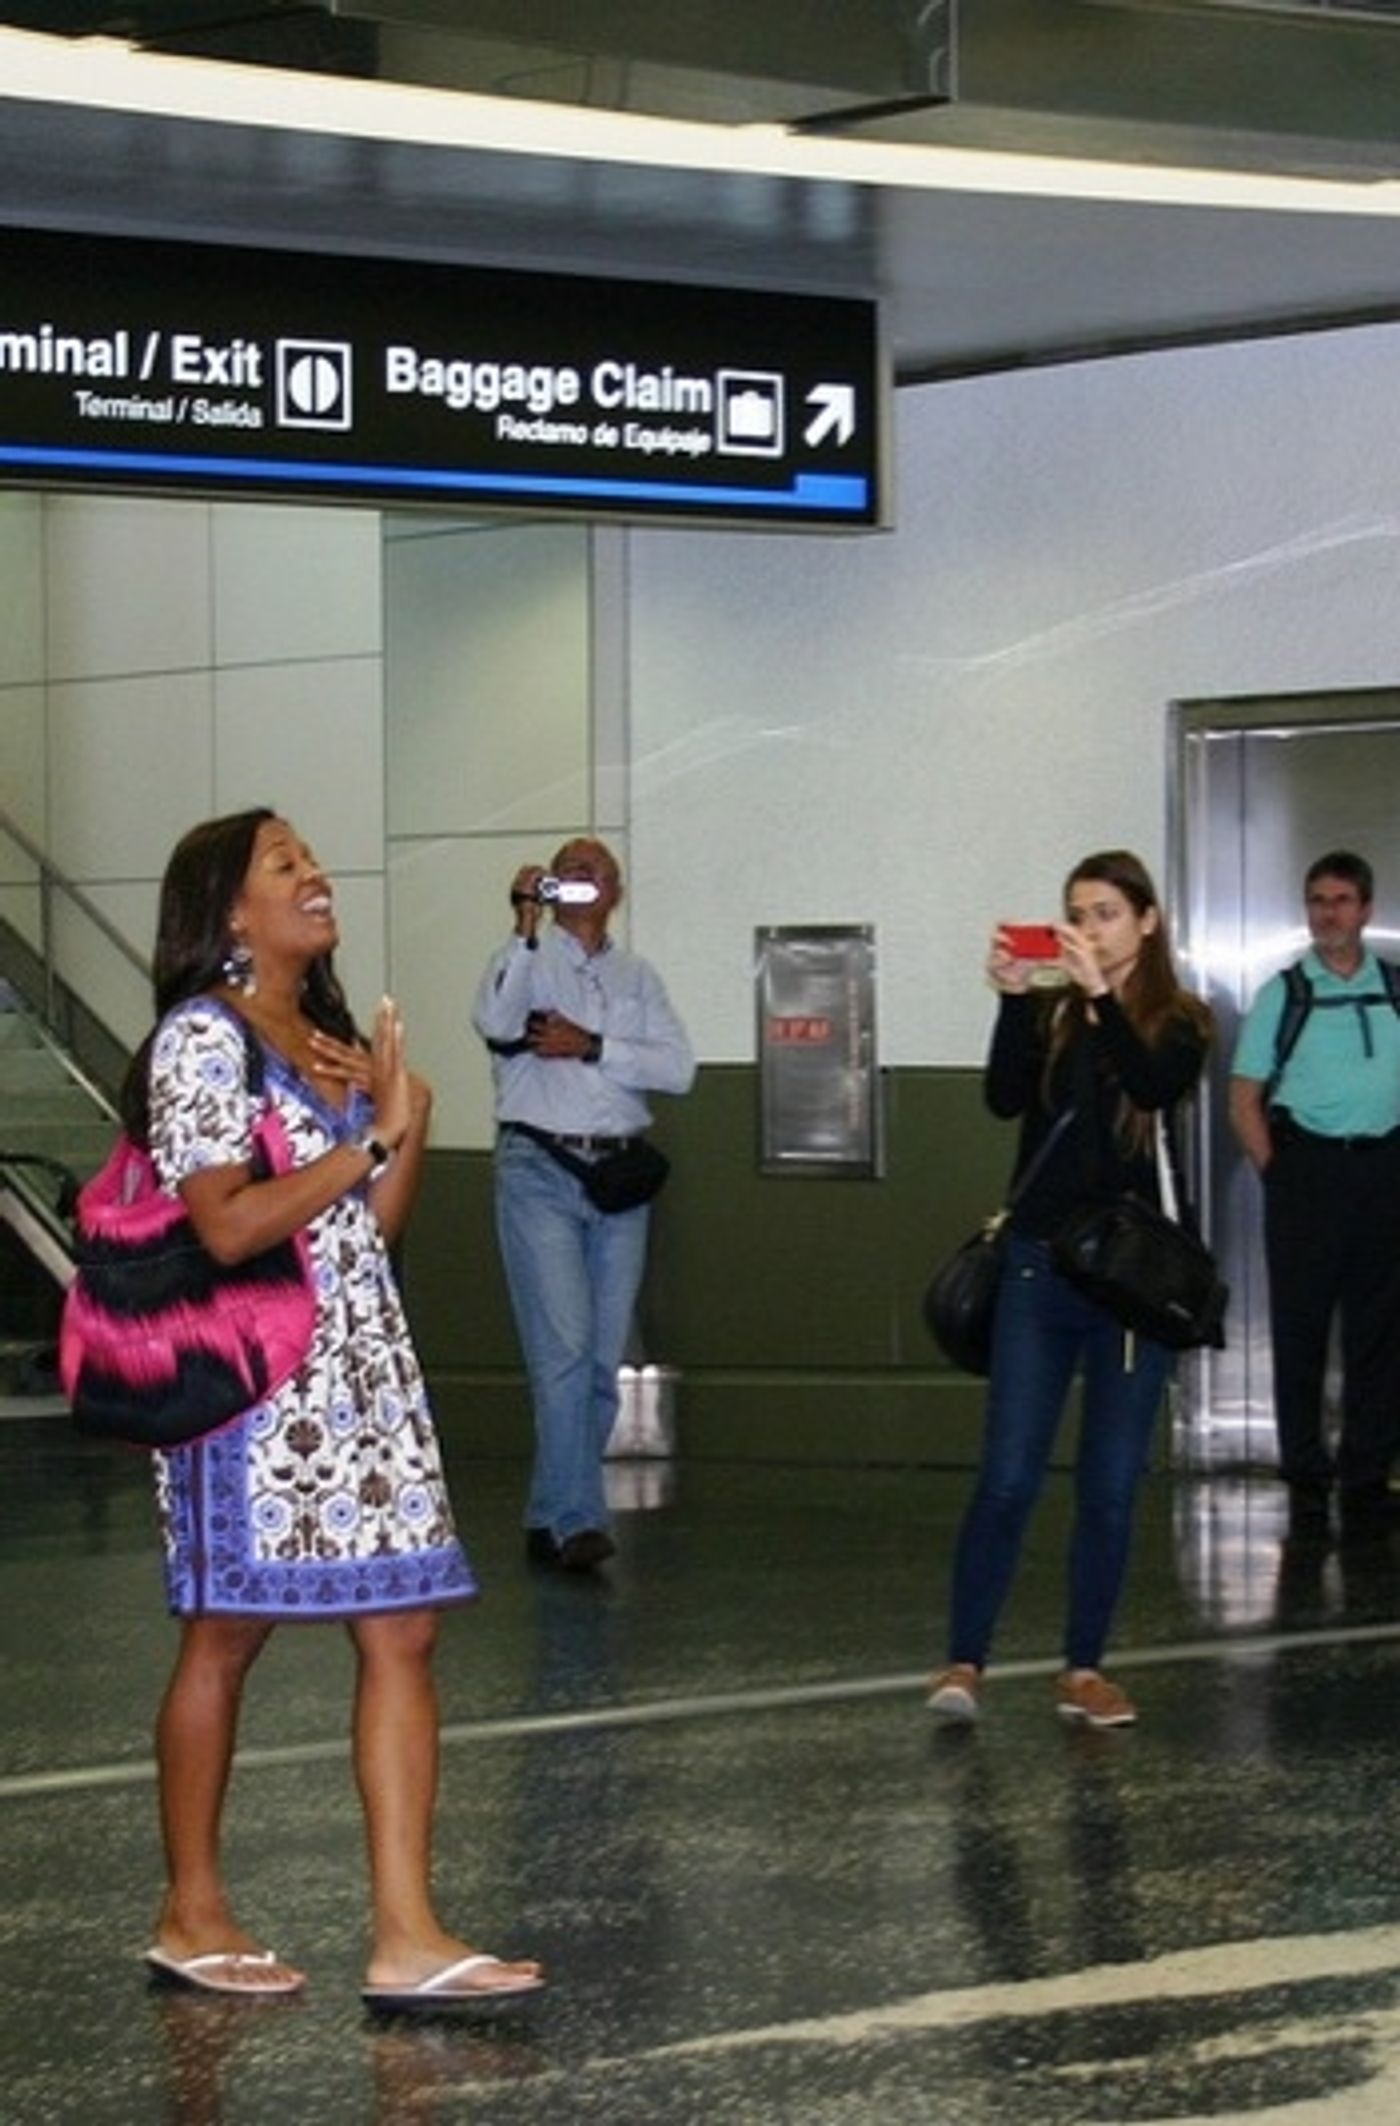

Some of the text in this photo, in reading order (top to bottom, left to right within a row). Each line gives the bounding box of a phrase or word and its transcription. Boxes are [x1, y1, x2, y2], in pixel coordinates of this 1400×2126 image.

[139, 331, 160, 381] /
[171, 334, 262, 388] Exit
[386, 346, 713, 413] Baggage Claim
[75, 390, 262, 429] Terminal / Salida
[497, 414, 712, 458] Reclamo de Equipaje
